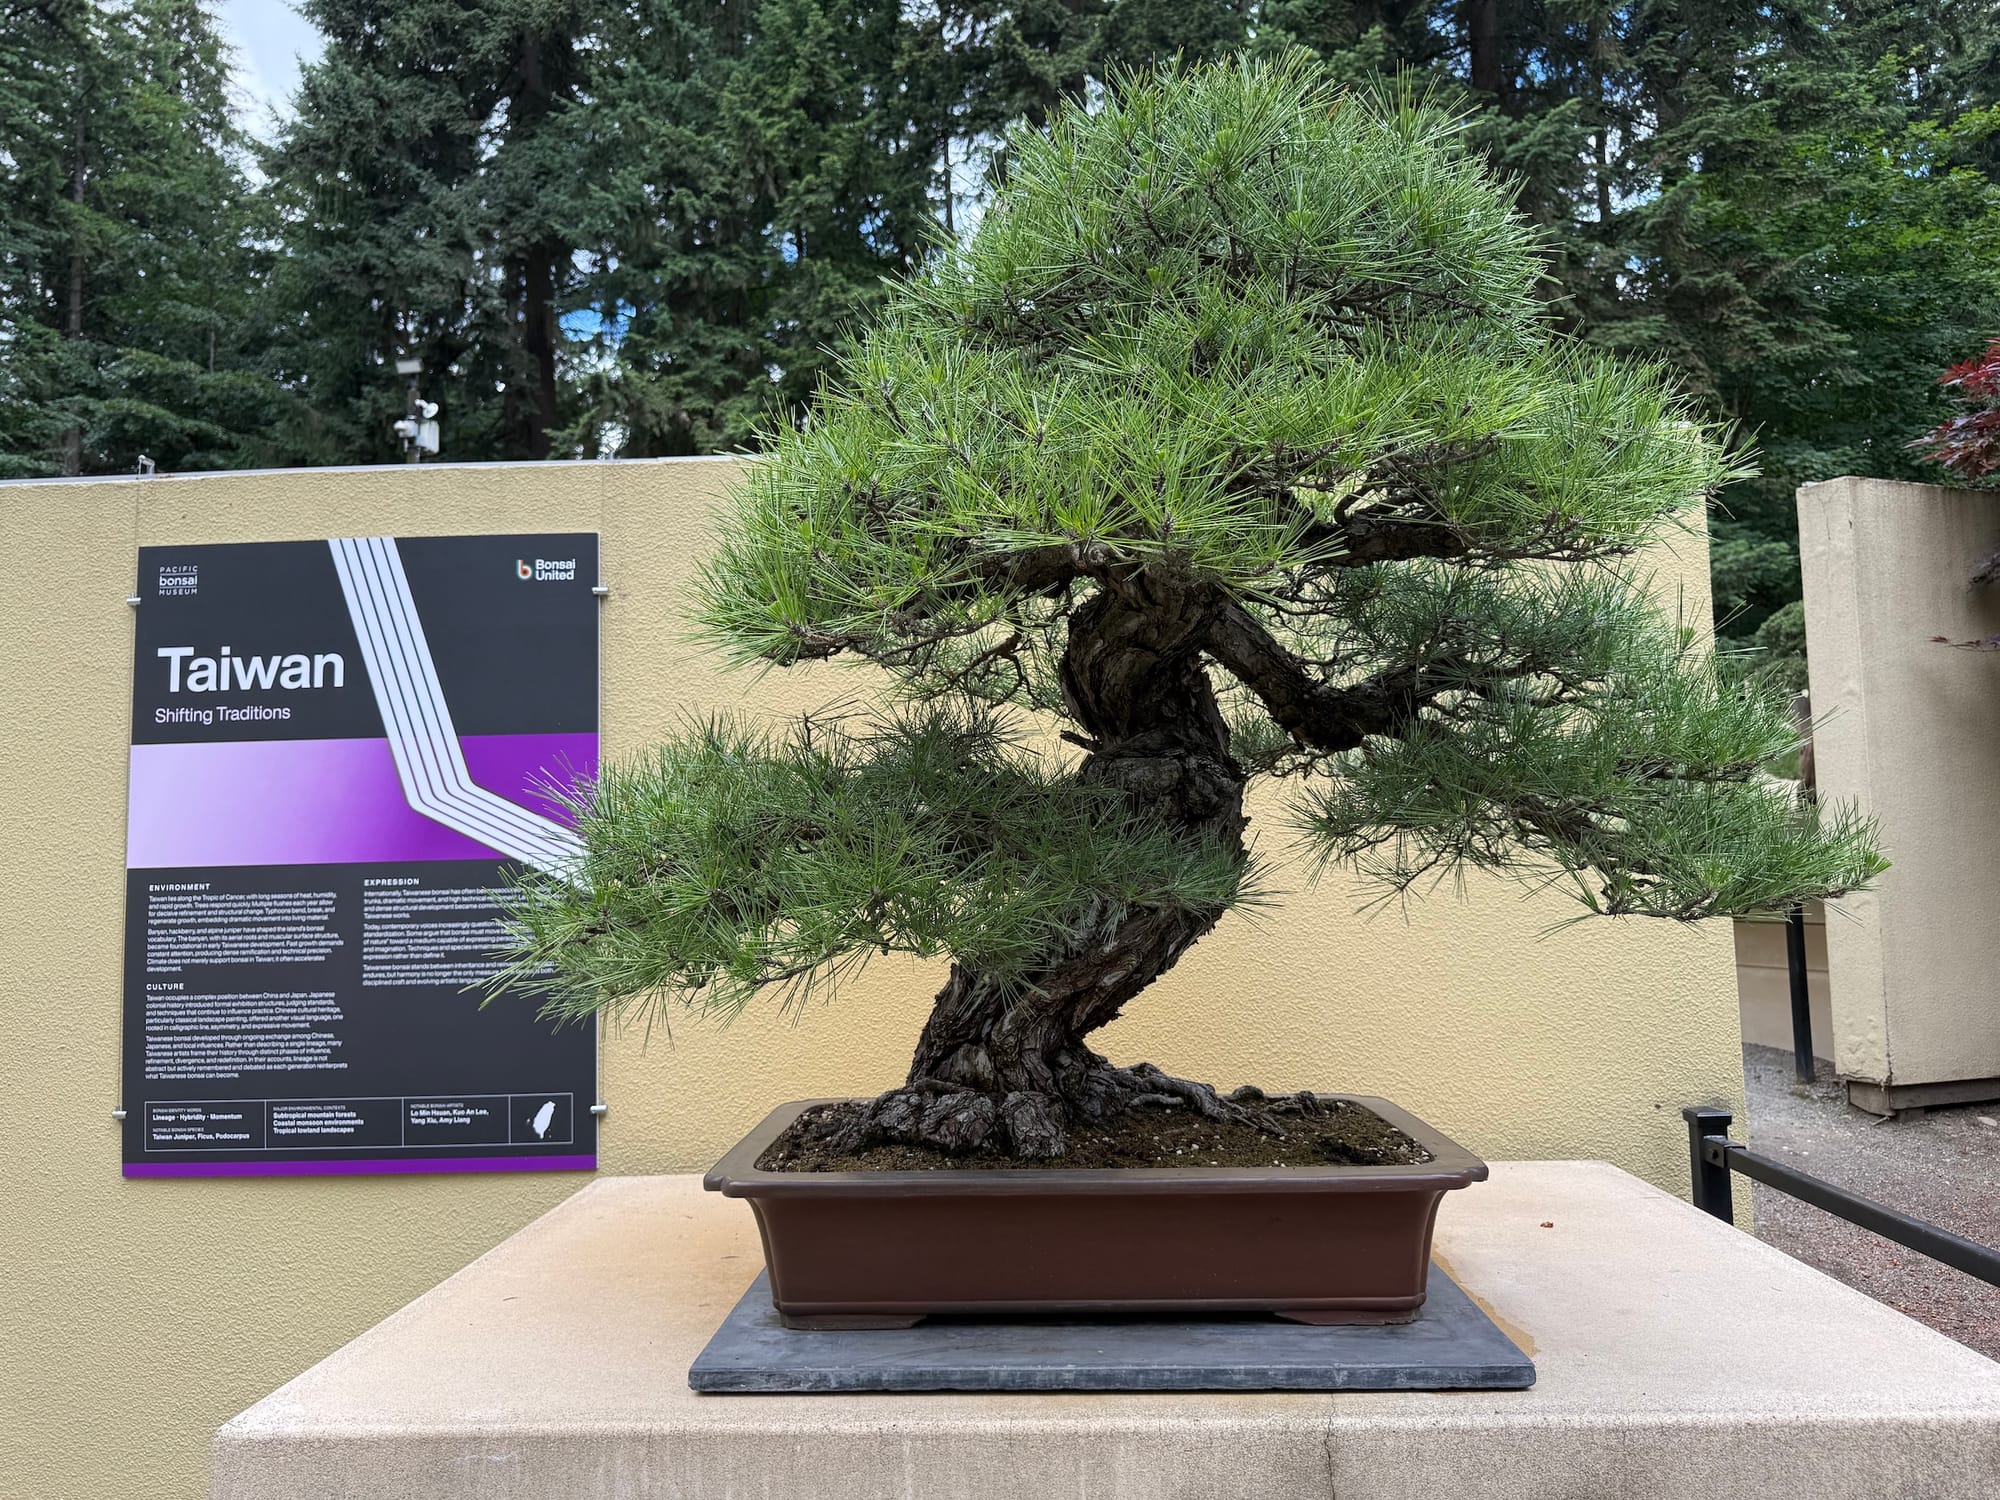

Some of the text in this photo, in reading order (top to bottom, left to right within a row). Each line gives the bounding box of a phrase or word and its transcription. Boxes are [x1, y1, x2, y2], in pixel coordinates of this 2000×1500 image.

[536, 559, 575, 569] Bonsai
[536, 570, 574, 580] United
[160, 576, 197, 586] bonsai
[158, 647, 344, 692] Taiwan
[155, 704, 290, 724] Shifting Traditions
